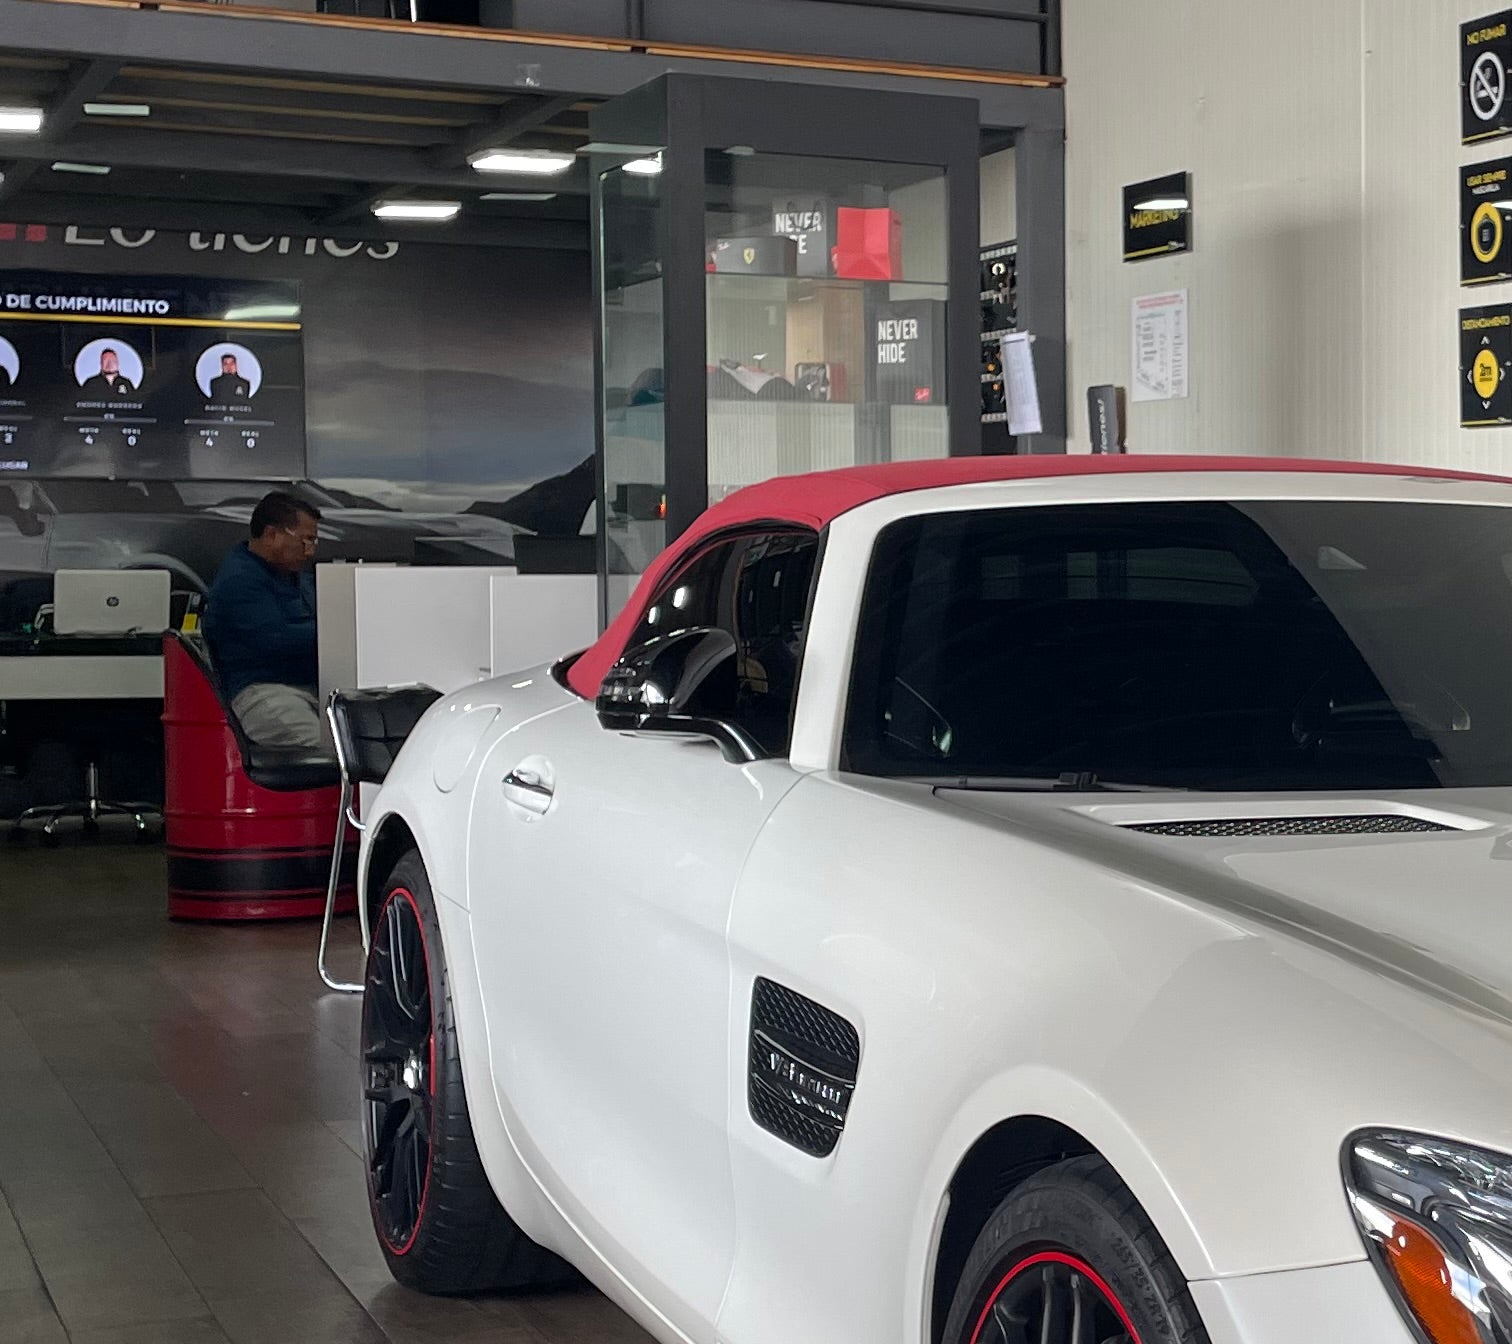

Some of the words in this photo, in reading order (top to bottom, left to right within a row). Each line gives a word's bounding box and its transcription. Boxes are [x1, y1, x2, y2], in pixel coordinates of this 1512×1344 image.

[775, 212, 823, 233] NEVER
[6, 293, 32, 309] DE
[35, 295, 170, 314] CUMPLIMIENTO
[877, 318, 918, 342] NEVER
[877, 343, 907, 364] HIDE
